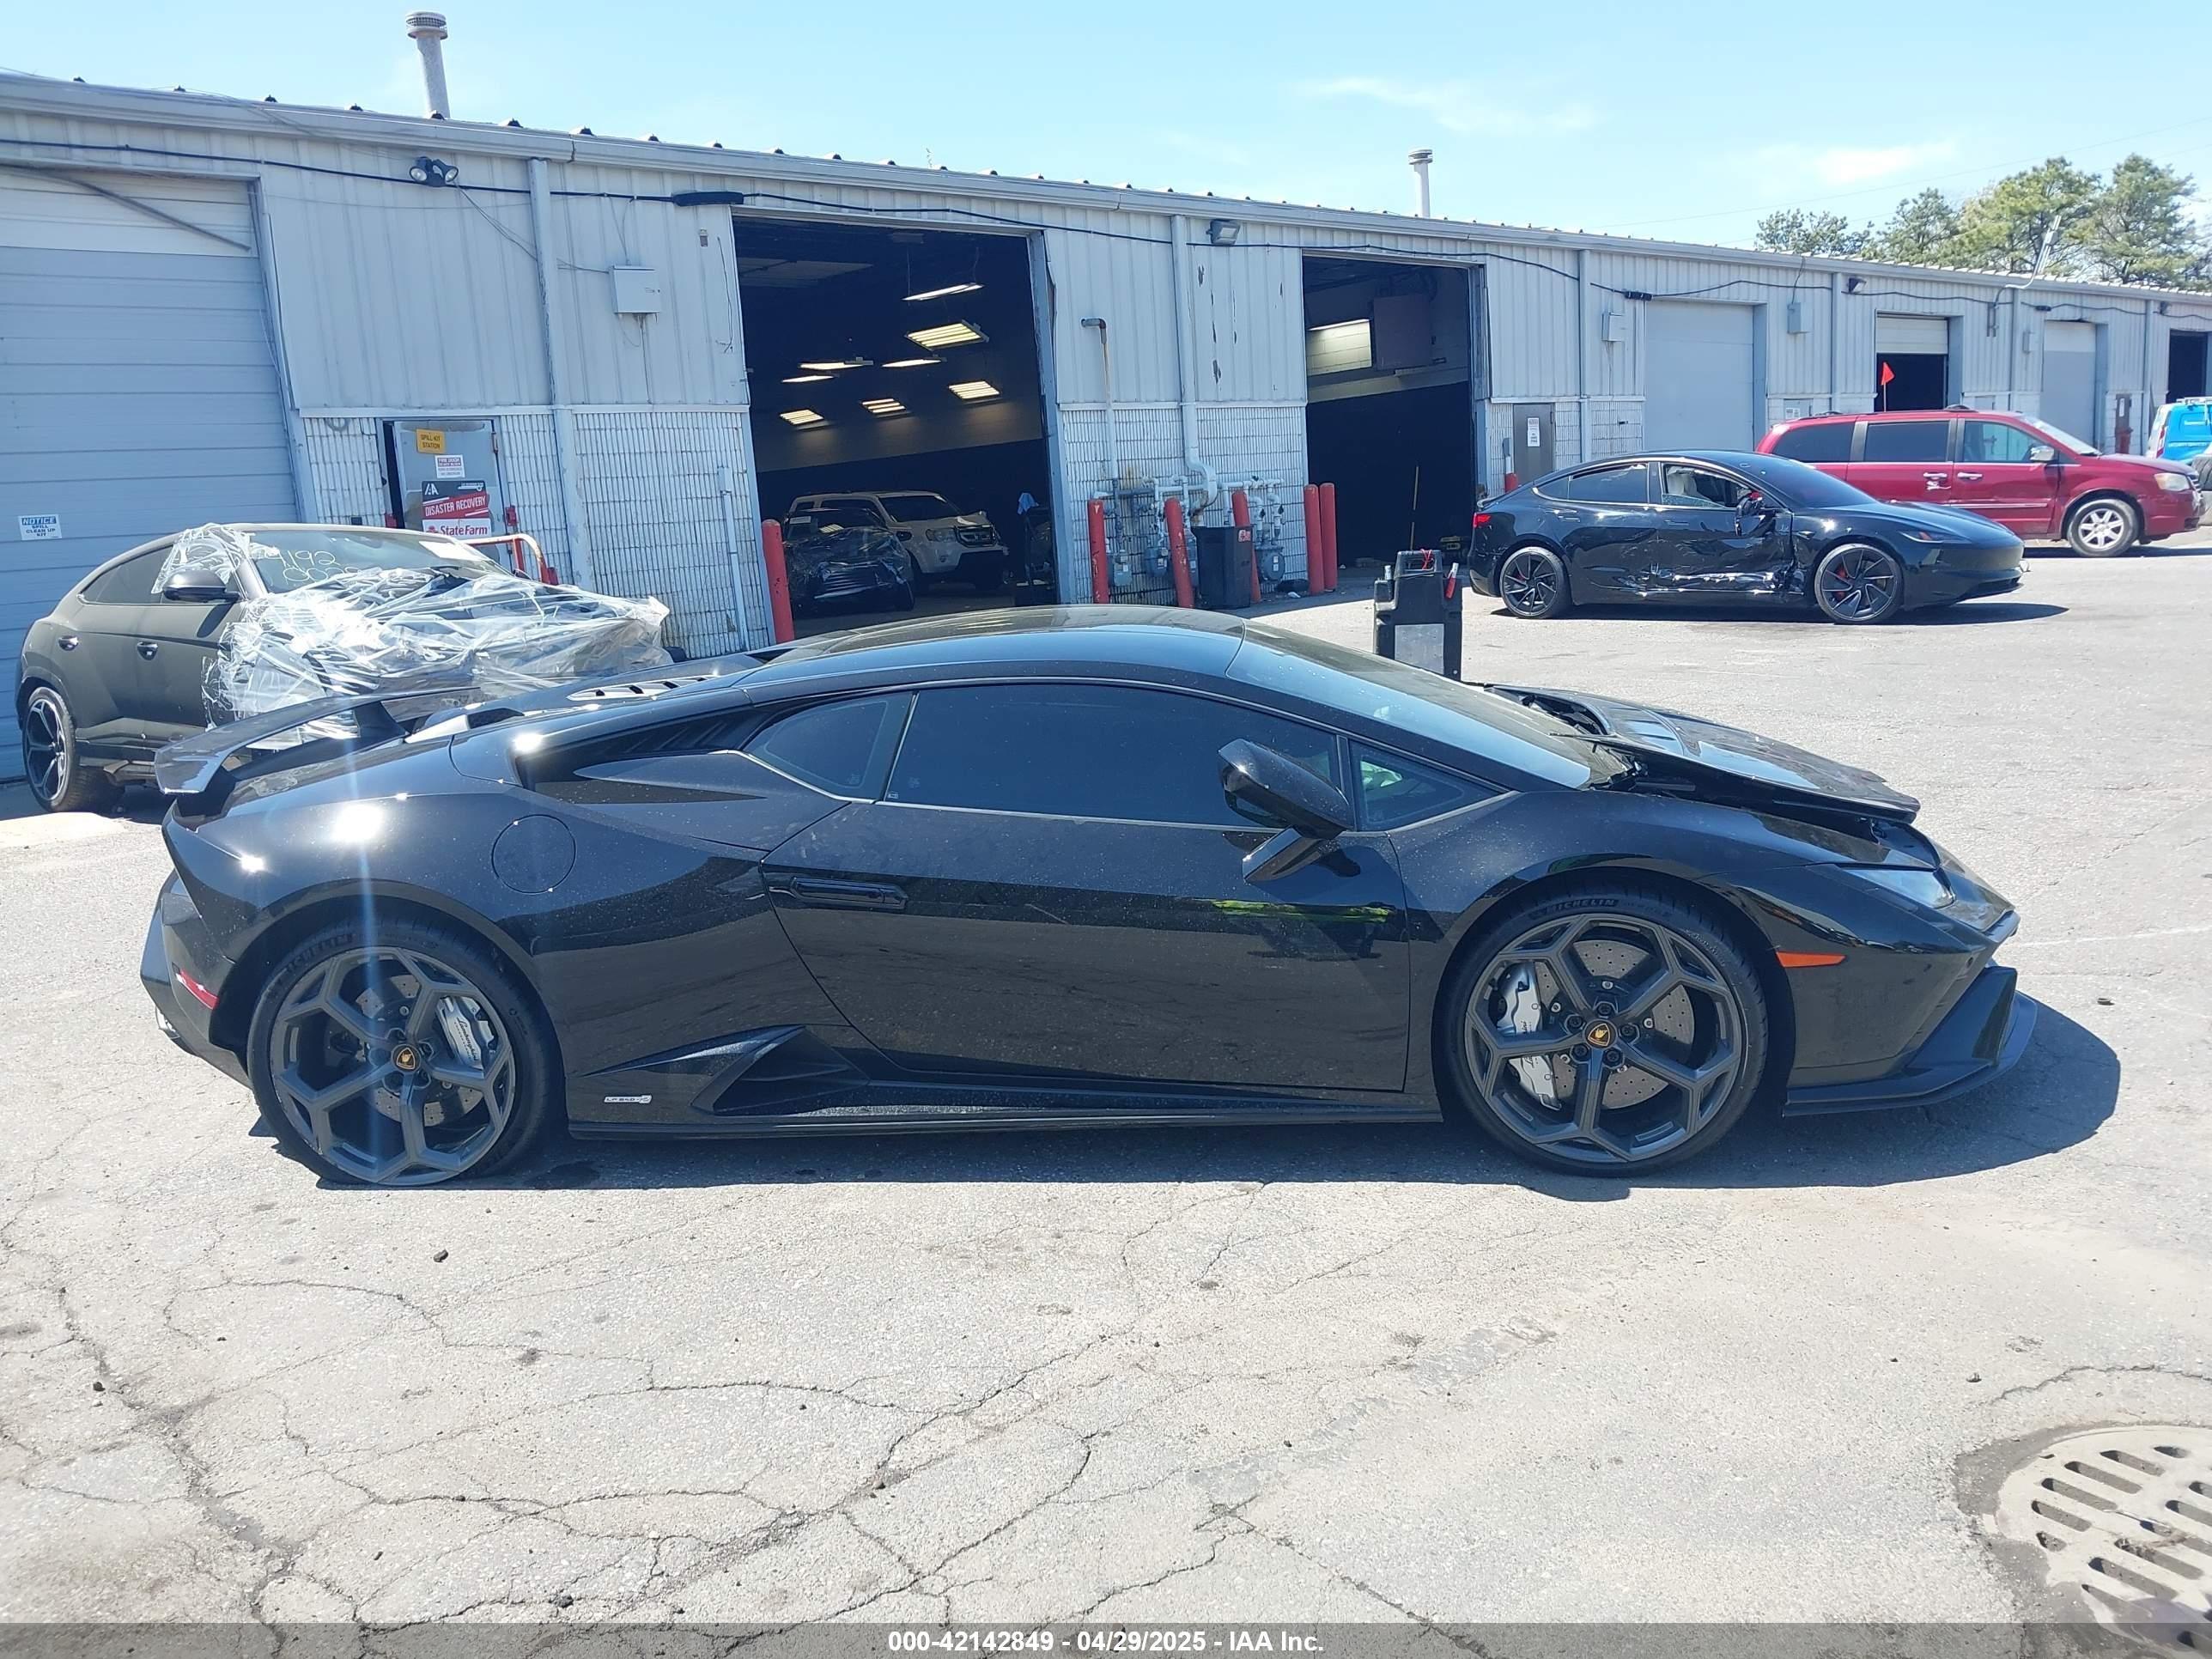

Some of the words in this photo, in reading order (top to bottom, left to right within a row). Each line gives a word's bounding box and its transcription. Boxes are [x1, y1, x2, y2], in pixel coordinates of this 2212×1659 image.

[425, 501, 455, 517] DISASTER
[456, 495, 486, 511] RECOVERY
[1552, 898, 1615, 911] MICHELIN
